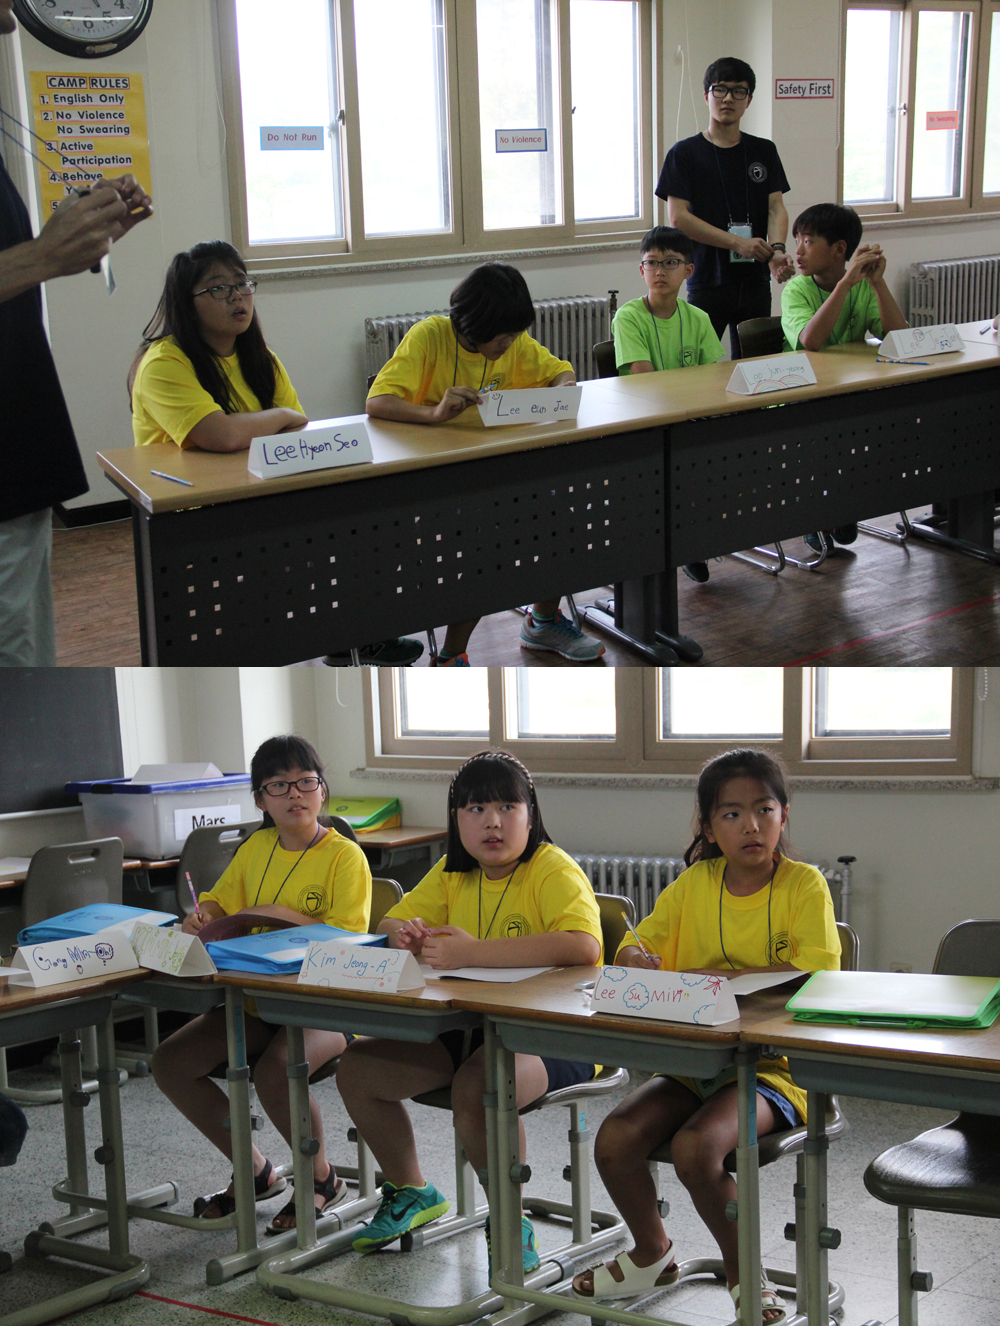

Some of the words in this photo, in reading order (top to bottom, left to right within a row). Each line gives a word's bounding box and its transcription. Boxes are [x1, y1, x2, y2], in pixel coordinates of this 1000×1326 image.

[82, 15, 94, 29] 6
[102, 11, 113, 24] 5
[48, 78, 86, 88] CAMP
[91, 78, 128, 88] RULES
[778, 84, 806, 96] Safety
[809, 83, 831, 94] First
[40, 95, 49, 104] 1.
[54, 94, 92, 104] English
[99, 94, 124, 104] Only
[43, 112, 53, 120] 2.
[56, 111, 72, 119] No
[78, 111, 124, 119] Violence
[57, 125, 73, 134] No
[79, 125, 130, 135] Swearing
[268, 133, 279, 141] Do
[284, 133, 297, 141] Not
[302, 133, 317, 141] Run
[47, 143, 56, 151] 3.
[60, 142, 94, 151] Active
[62, 156, 132, 166] Participation
[62, 172, 103, 181] Behave
[497, 395, 520, 416] Lee
[263, 443, 298, 465] Lee
[299, 438, 332, 460] Hyeon
[334, 433, 358, 451] Seo
[307, 947, 336, 970] Kim
[594, 976, 616, 1000] Lee
